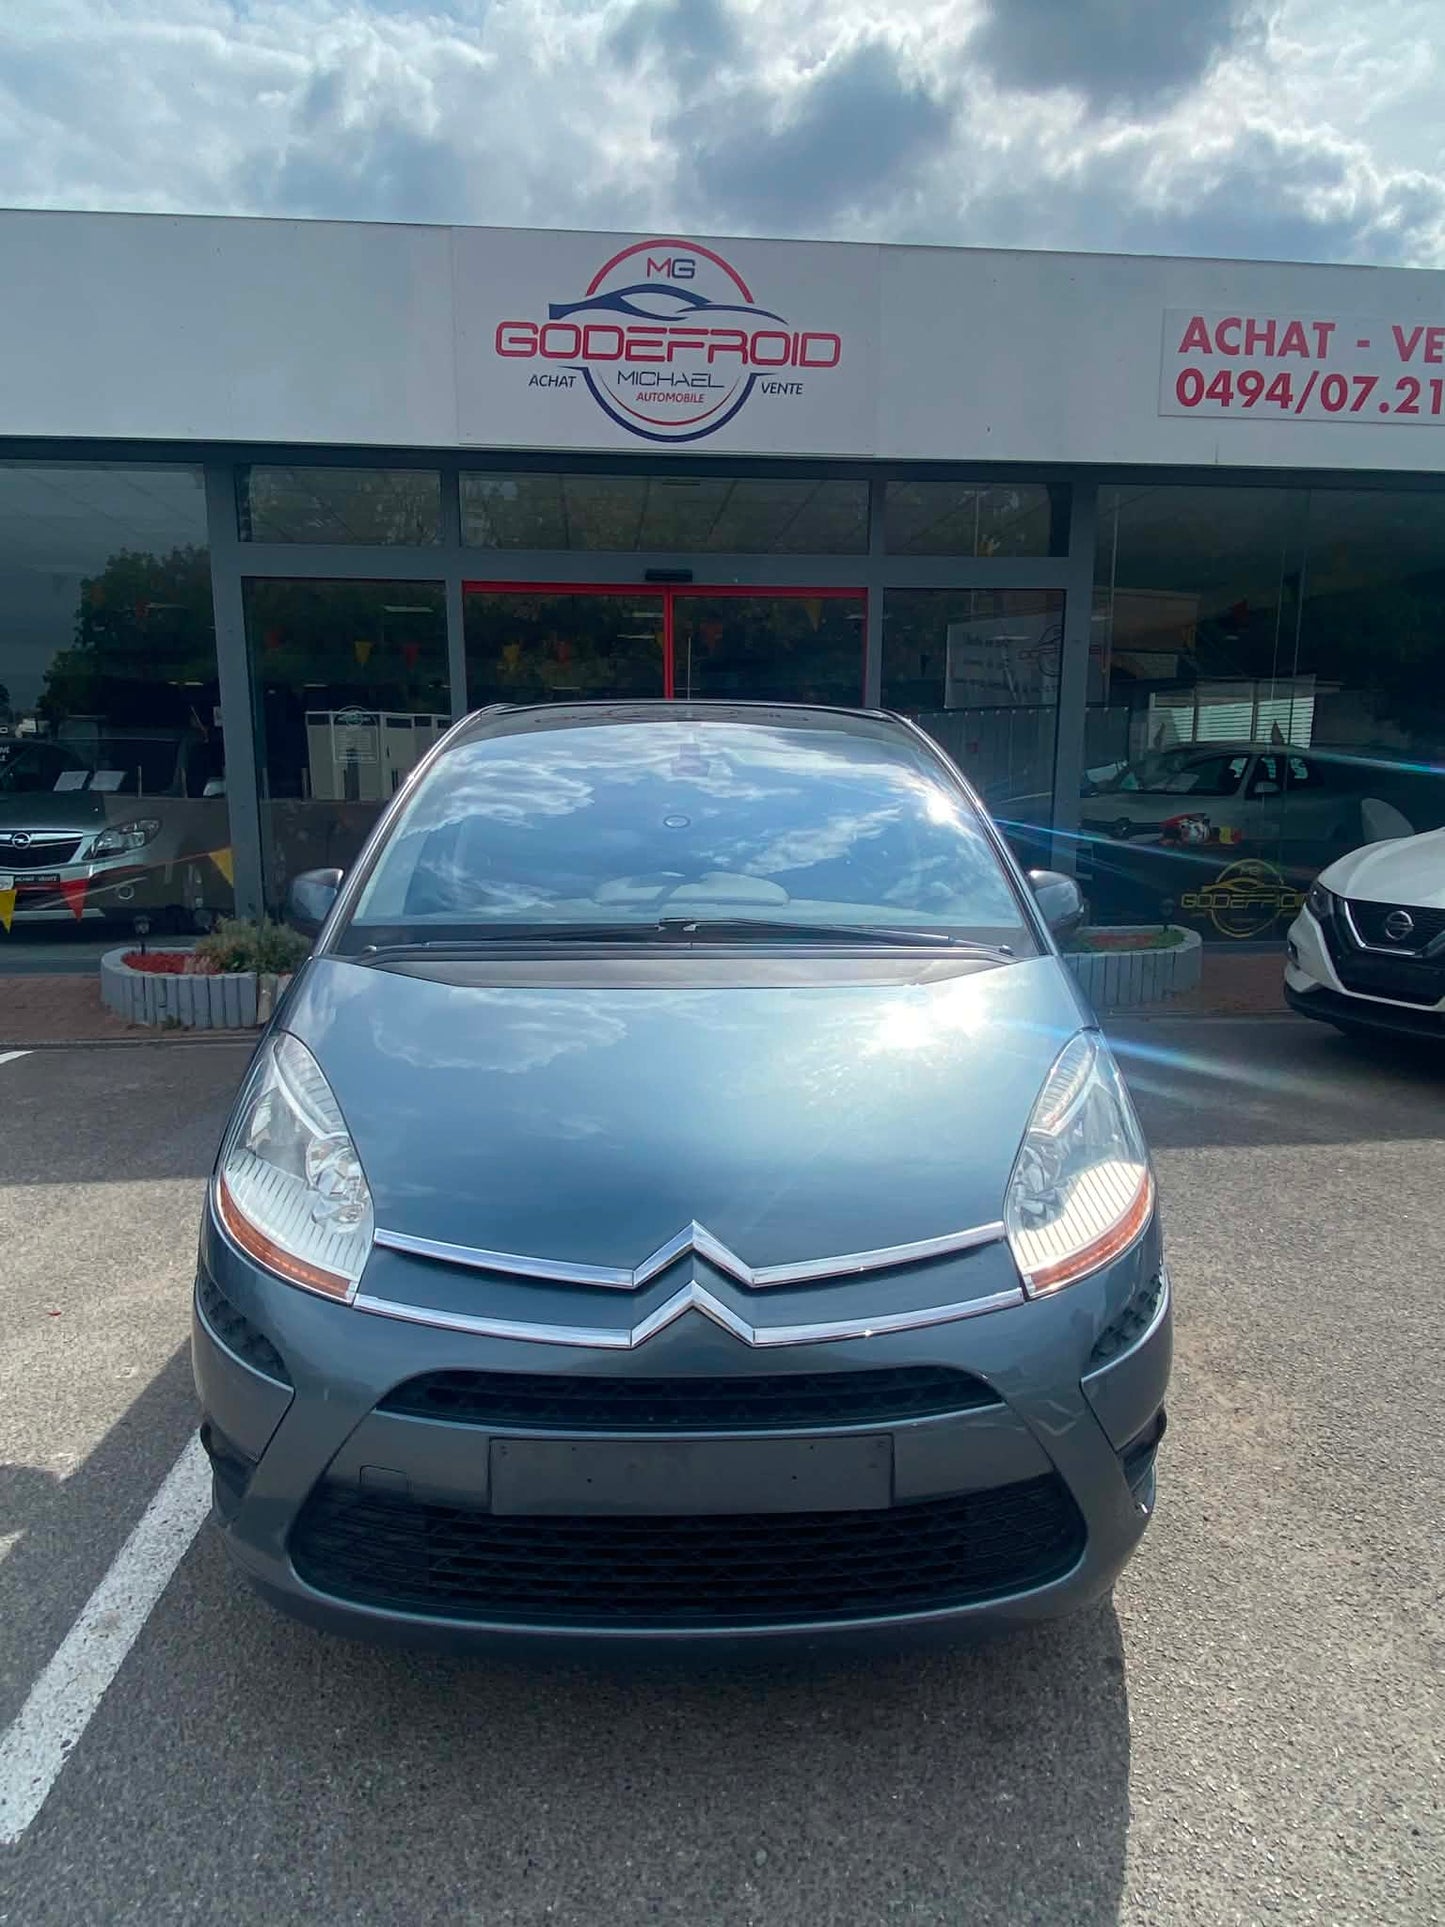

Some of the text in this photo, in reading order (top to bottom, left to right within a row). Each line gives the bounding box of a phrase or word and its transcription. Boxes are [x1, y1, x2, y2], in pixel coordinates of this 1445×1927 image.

[647, 257, 695, 279] MG
[495, 321, 841, 368] GODEFROID
[1177, 316, 1336, 359] ACHAT
[1391, 325, 1445, 363] VE
[528, 374, 576, 388] ACHAT
[617, 370, 724, 388] MICHAEL
[761, 380, 803, 396] VENTE
[636, 391, 705, 404] AUTOMOBILE
[1176, 367, 1443, 415] 0494/07.21
